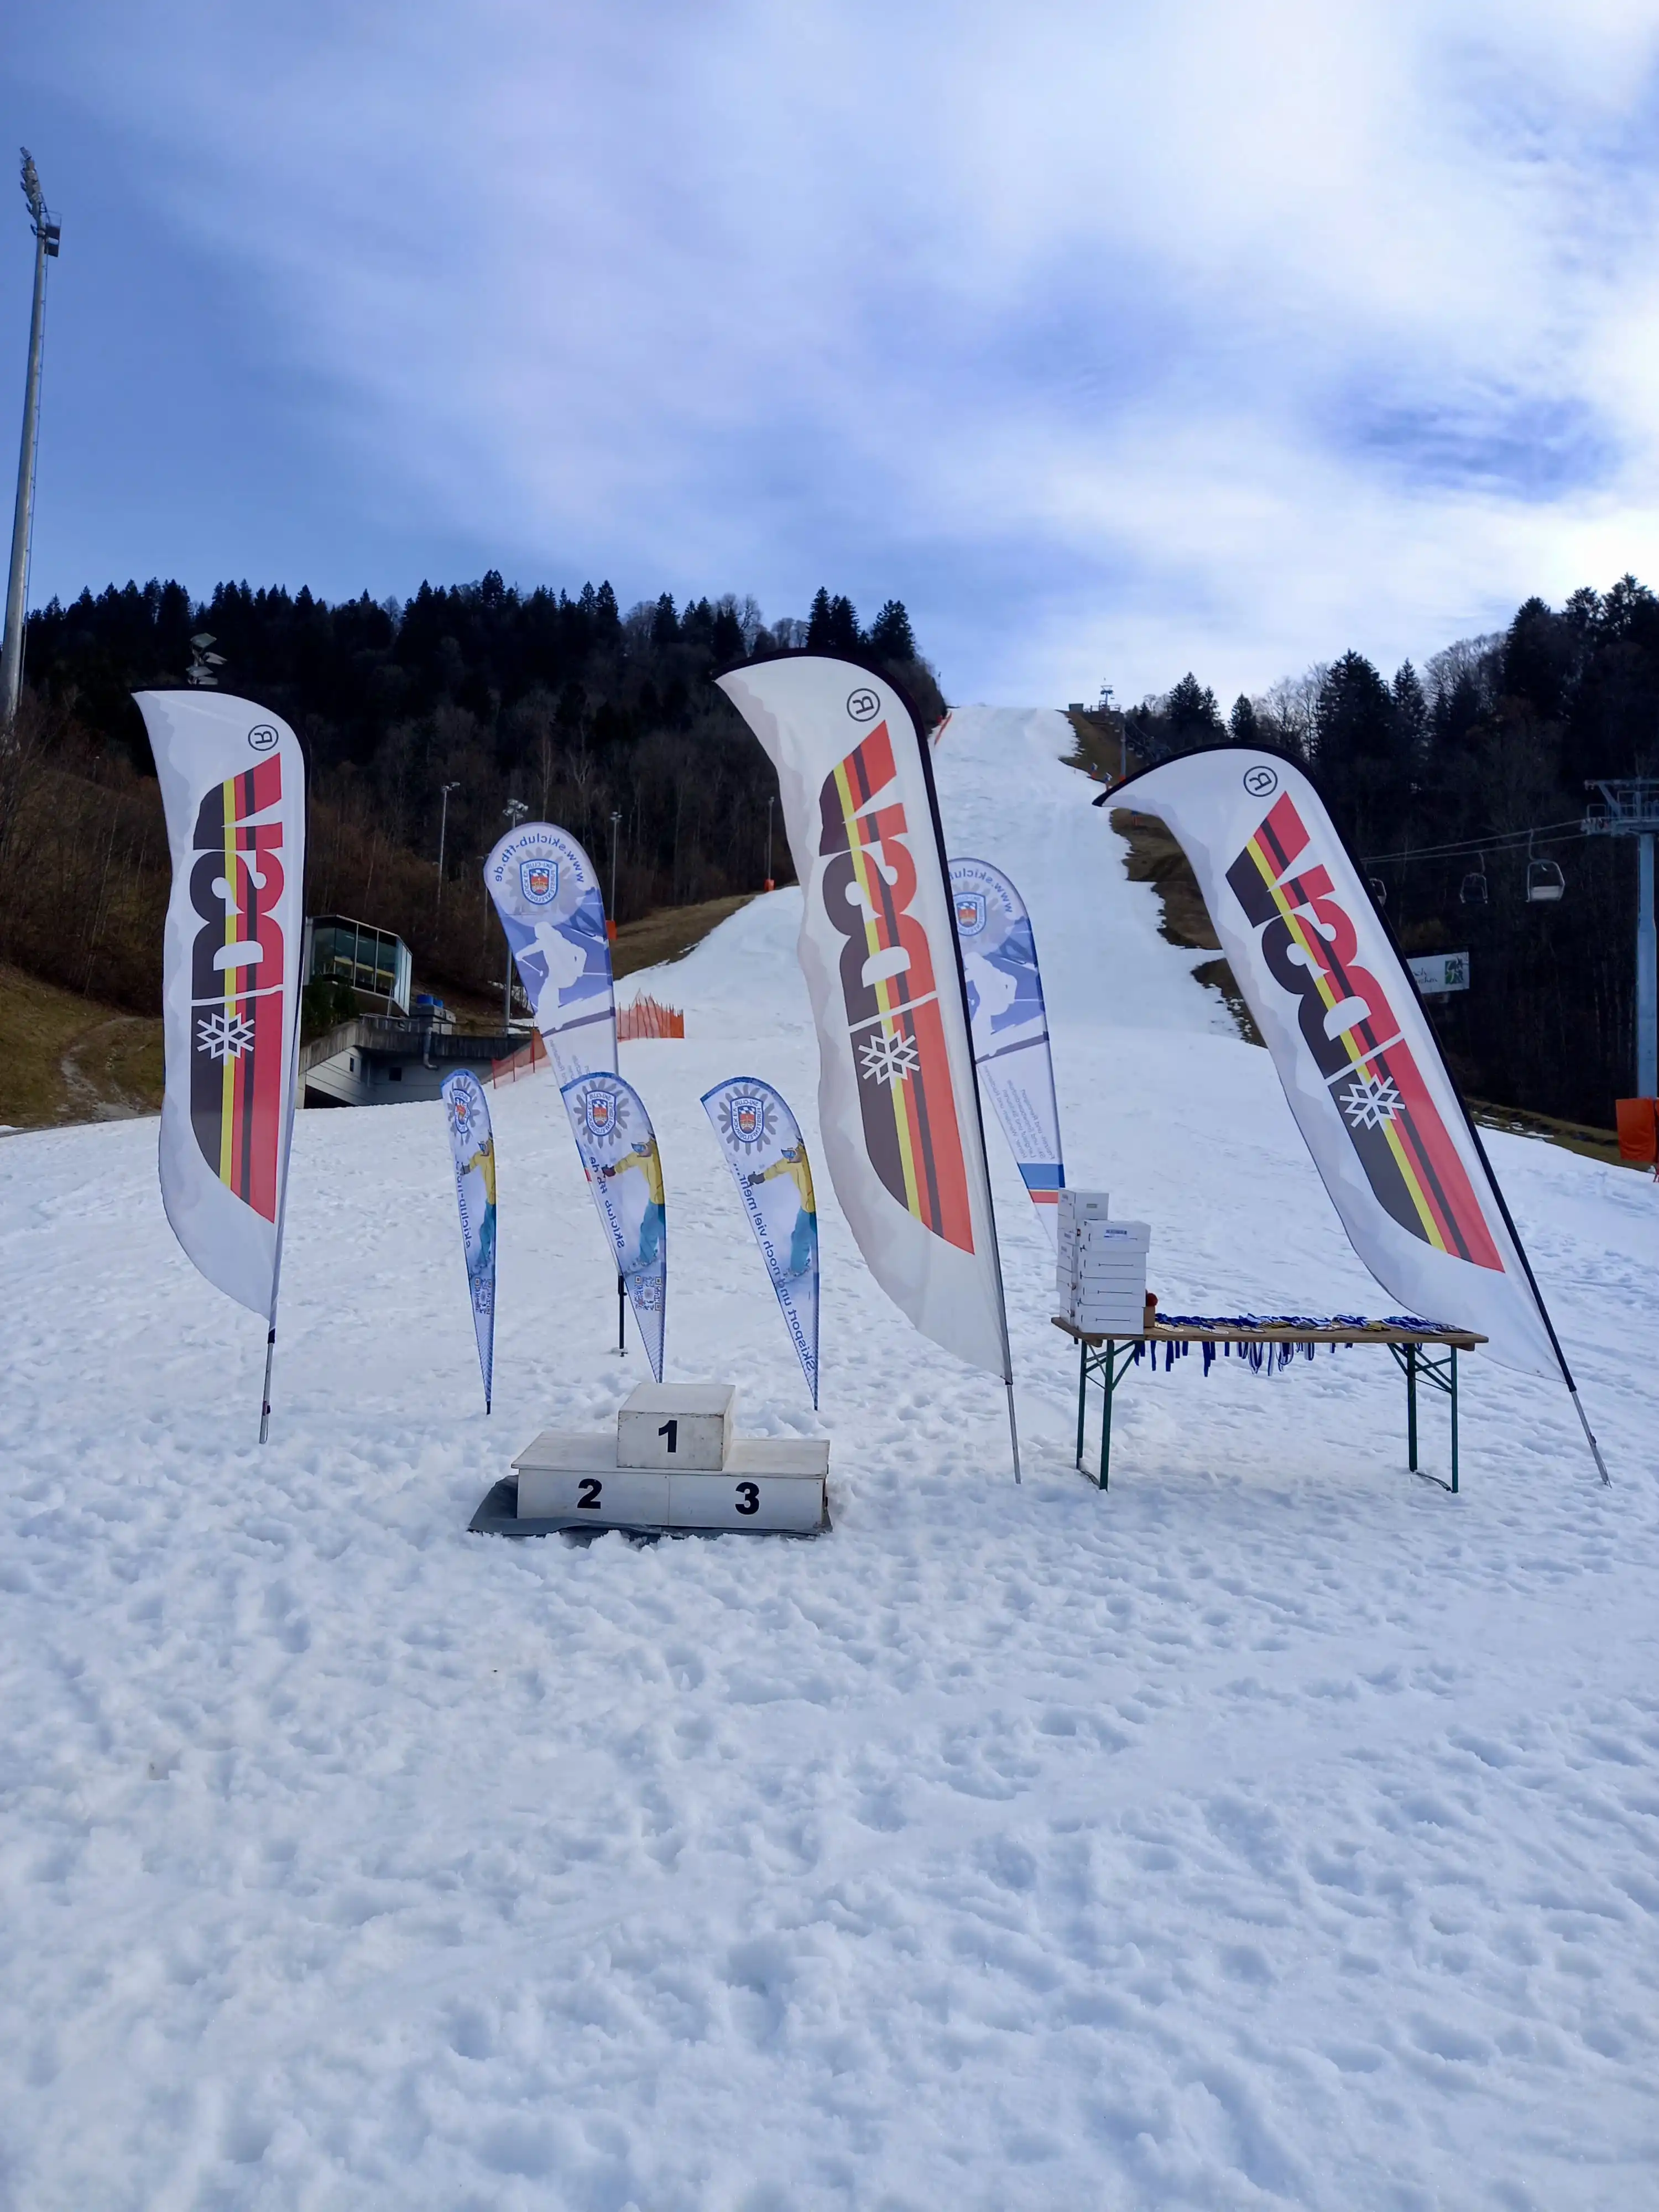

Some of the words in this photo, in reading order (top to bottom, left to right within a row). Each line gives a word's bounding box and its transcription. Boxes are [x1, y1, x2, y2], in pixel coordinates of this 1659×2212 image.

[658, 1420, 678, 1453] 1
[577, 1478, 602, 1509] 2
[735, 1482, 760, 1515] 3
